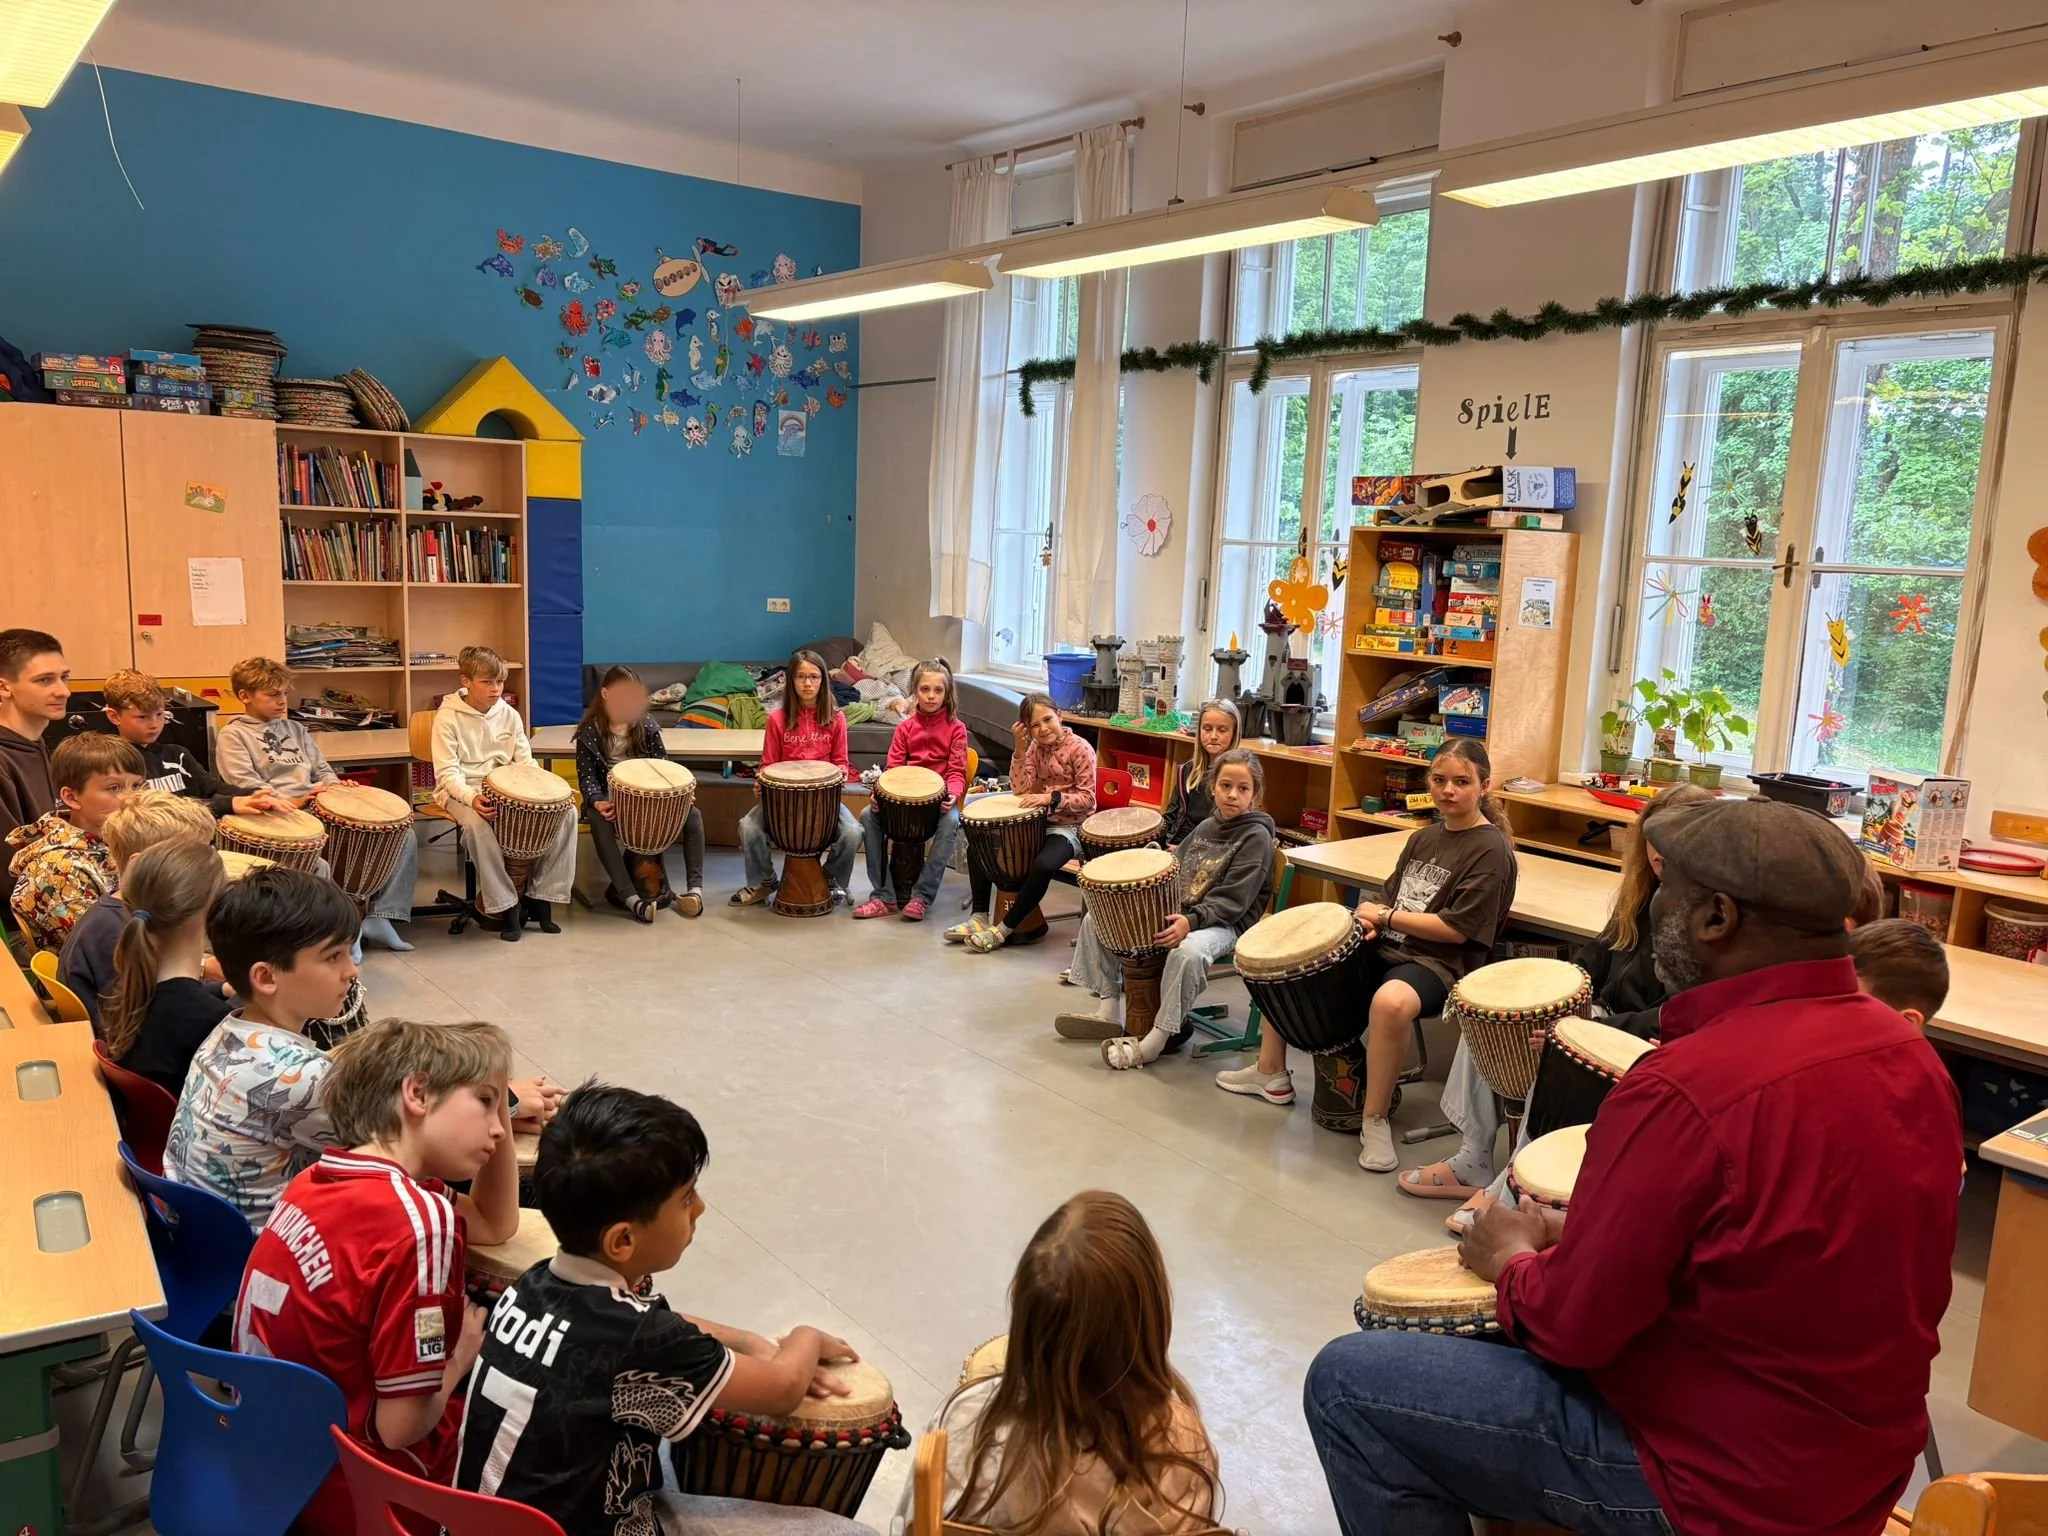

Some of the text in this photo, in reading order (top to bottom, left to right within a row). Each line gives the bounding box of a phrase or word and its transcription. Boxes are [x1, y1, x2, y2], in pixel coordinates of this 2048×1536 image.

[1457, 393, 1551, 430] SpielE
[1507, 468, 1517, 504] KLASK
[488, 1285, 571, 1368] Rodi
